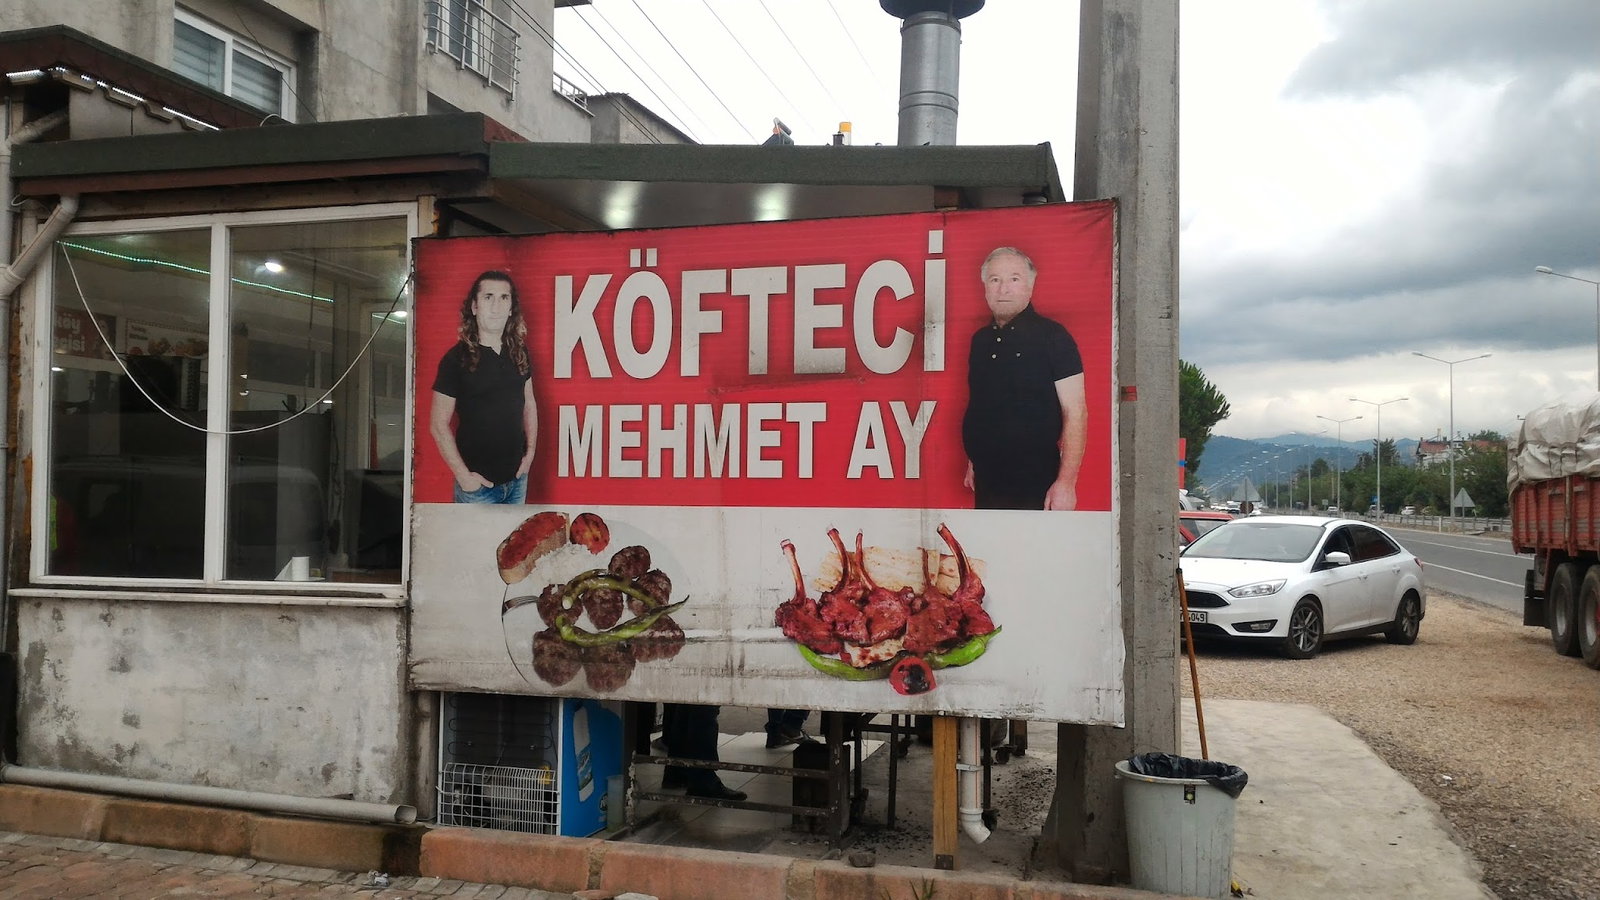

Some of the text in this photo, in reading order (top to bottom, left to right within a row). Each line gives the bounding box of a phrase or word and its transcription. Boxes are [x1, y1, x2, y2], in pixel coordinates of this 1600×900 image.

[554, 230, 946, 380] KÖFTECİ
[557, 401, 937, 479] MEHMET AY
